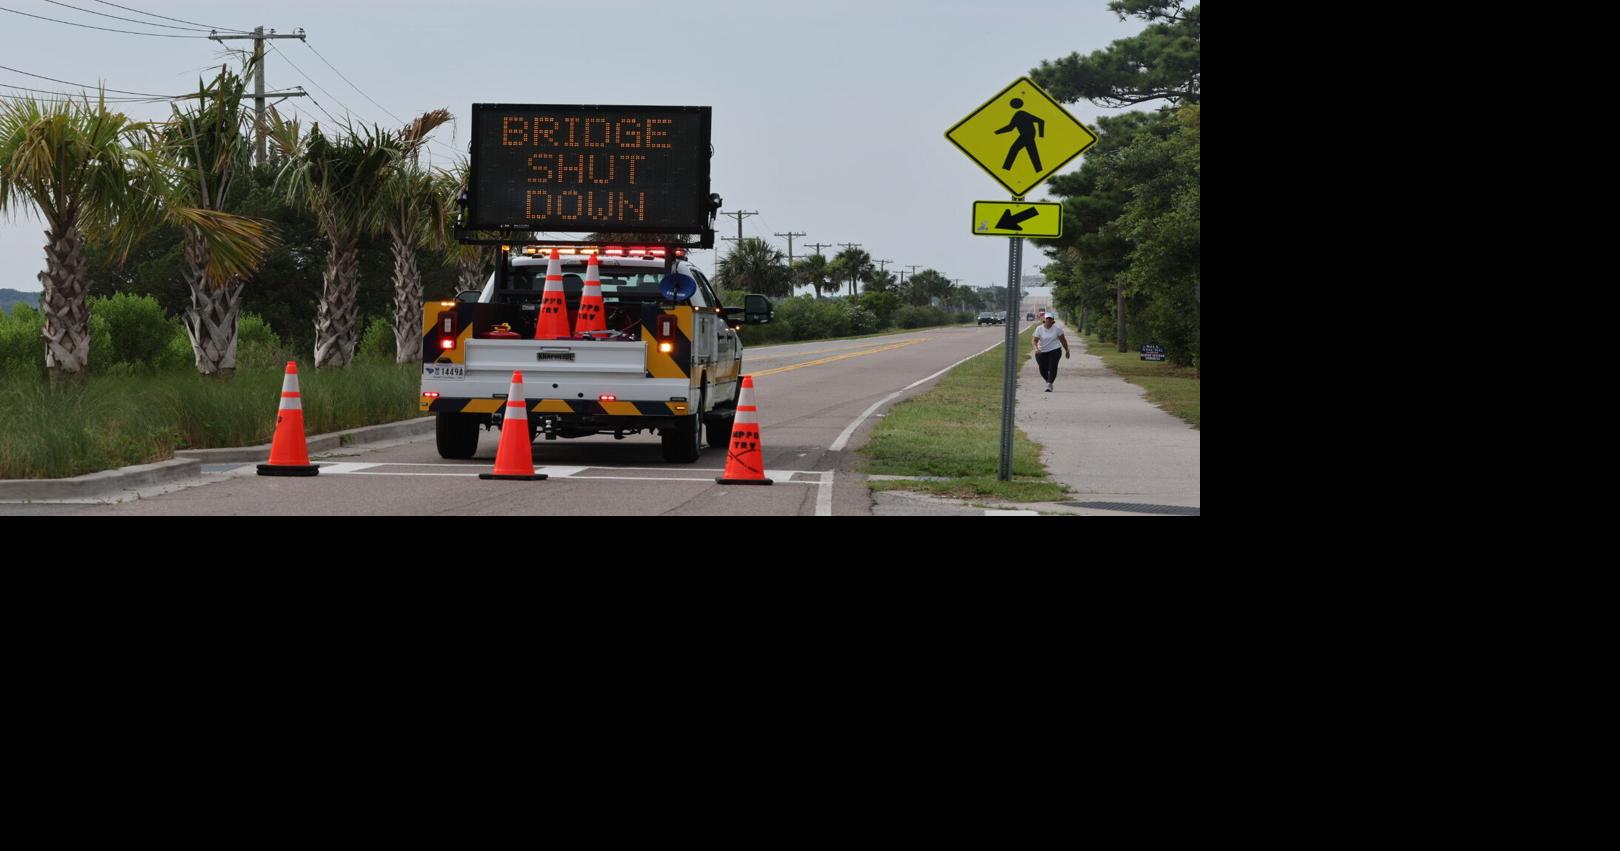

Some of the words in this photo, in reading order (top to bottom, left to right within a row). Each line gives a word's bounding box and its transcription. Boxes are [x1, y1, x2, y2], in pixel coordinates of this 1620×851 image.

[502, 116, 673, 148] BRIDGE
[527, 153, 646, 185] SHUT
[526, 190, 645, 221] DOWN
